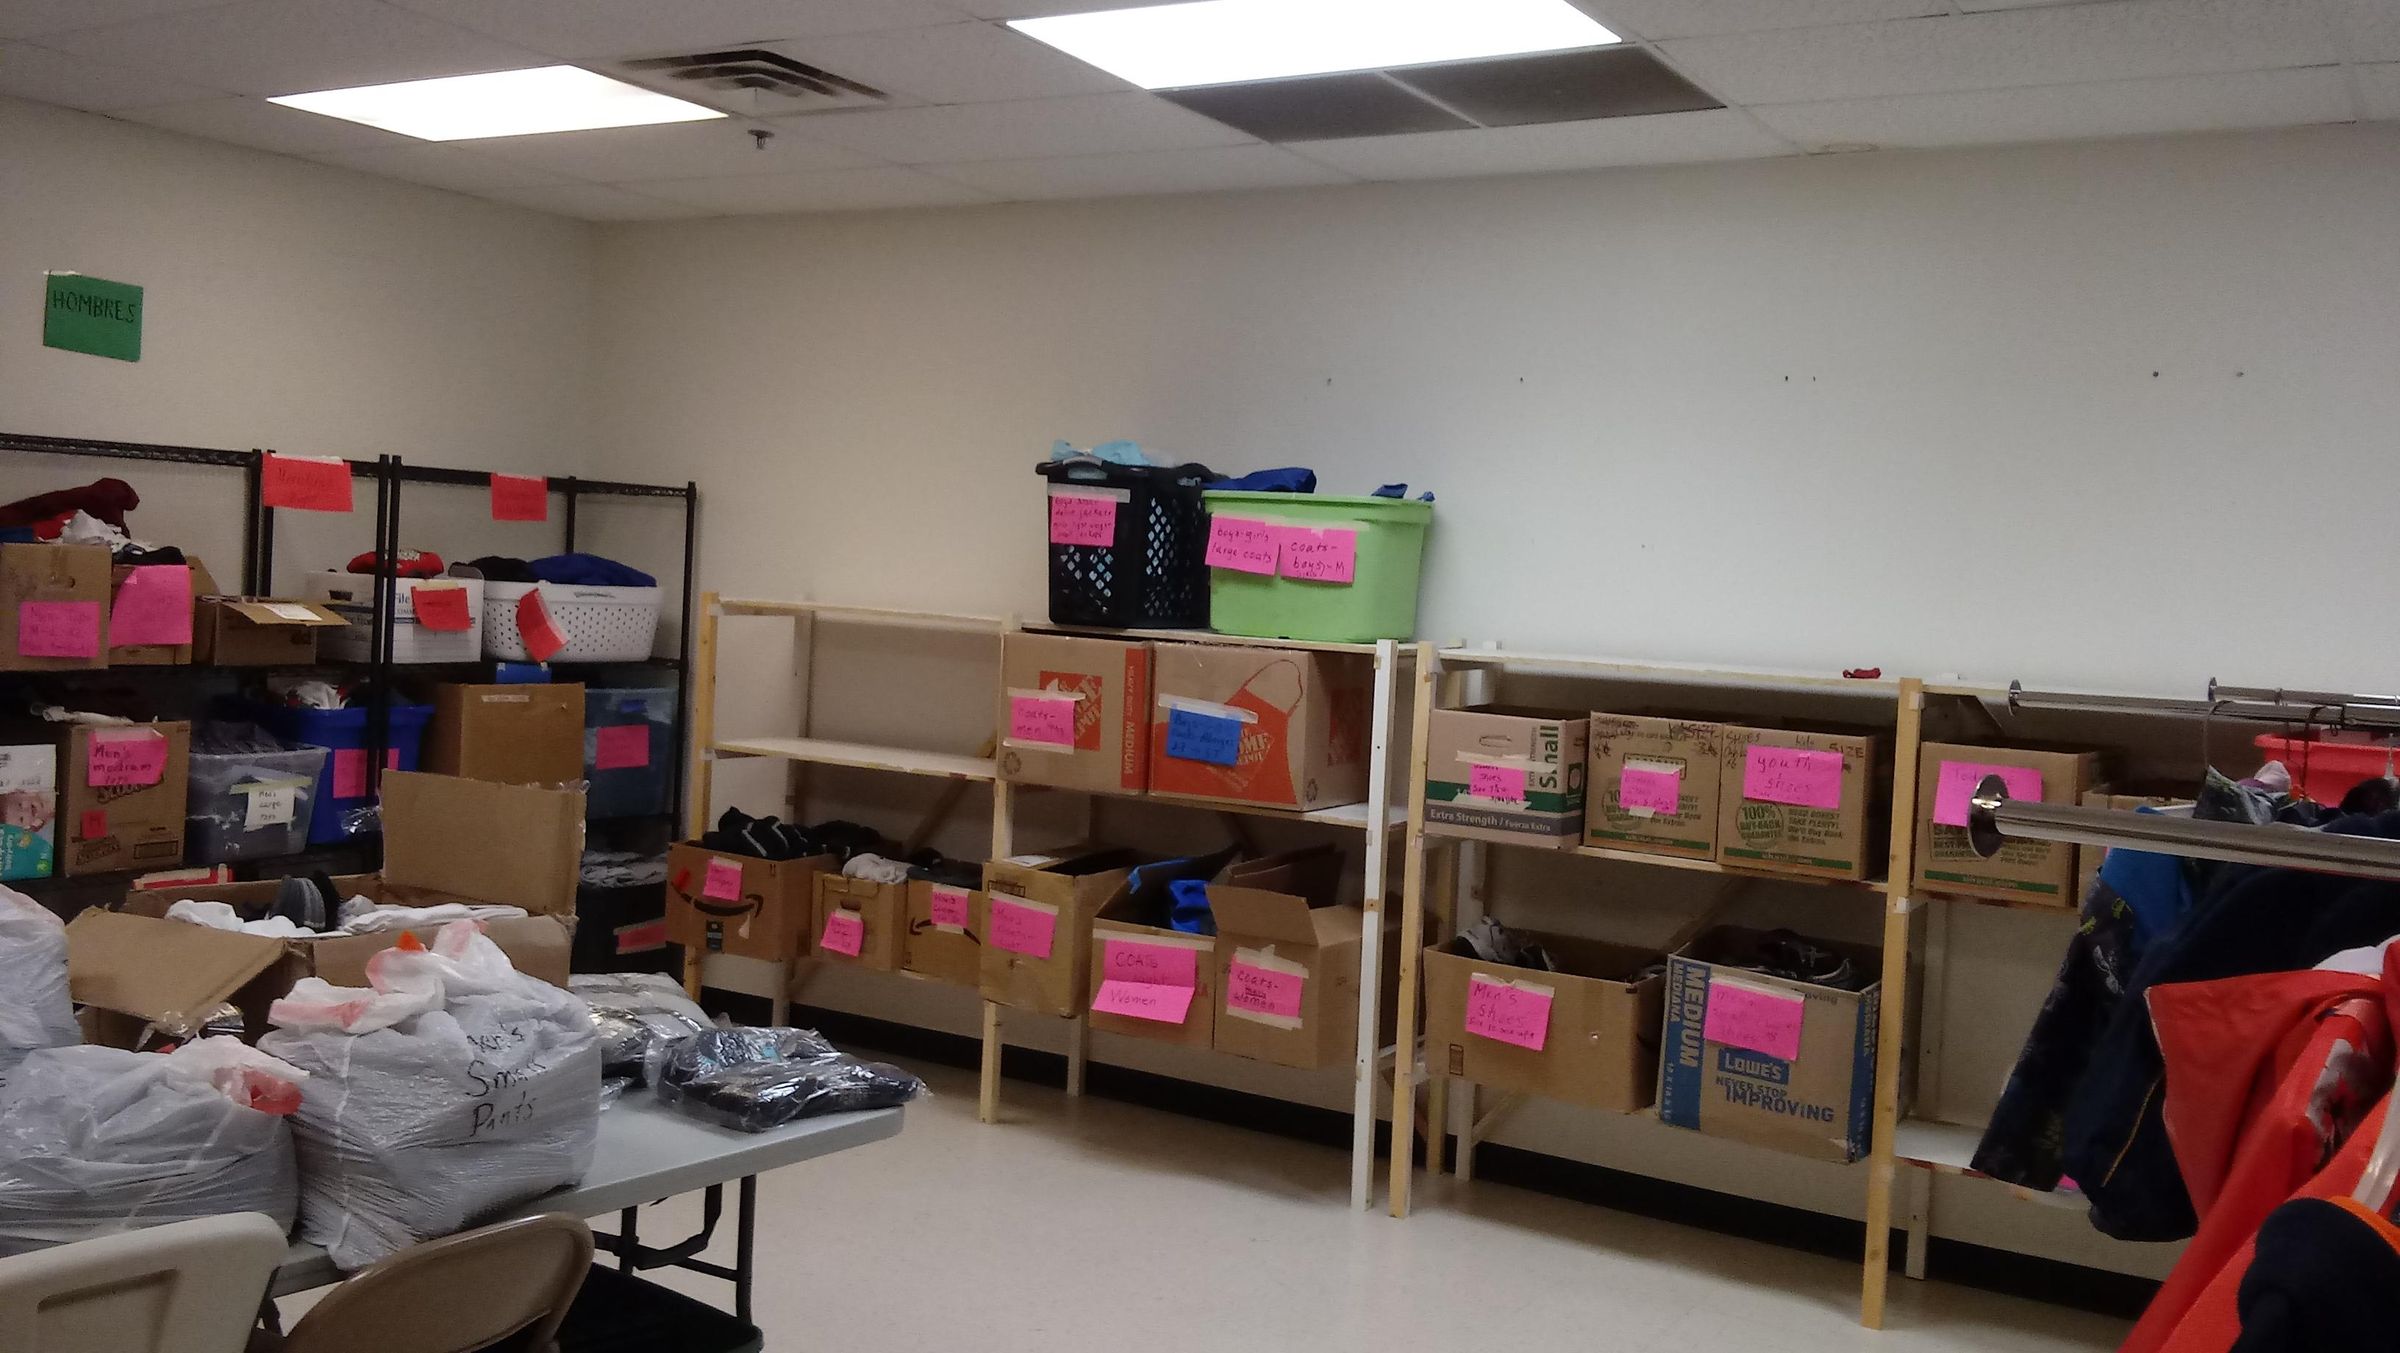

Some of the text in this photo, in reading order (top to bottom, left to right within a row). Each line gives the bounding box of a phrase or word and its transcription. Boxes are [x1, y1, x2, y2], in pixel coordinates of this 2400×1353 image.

[52, 290, 136, 323] HOMBRES
[1243, 551, 1272, 563] coats
[1124, 721, 1135, 775] MEDIUM
[1829, 742, 1864, 759] SIZE
[1430, 808, 1454, 822] Extra
[1456, 811, 1498, 827] Strength
[1743, 805, 1776, 821] 100%
[1111, 988, 1156, 1006] Women
[1679, 966, 1706, 1068] MEDIUM
[1725, 1053, 1782, 1081] LOWE'S
[1715, 1075, 1753, 1093] NEVER
[1725, 1083, 1834, 1122] IMPROVING
